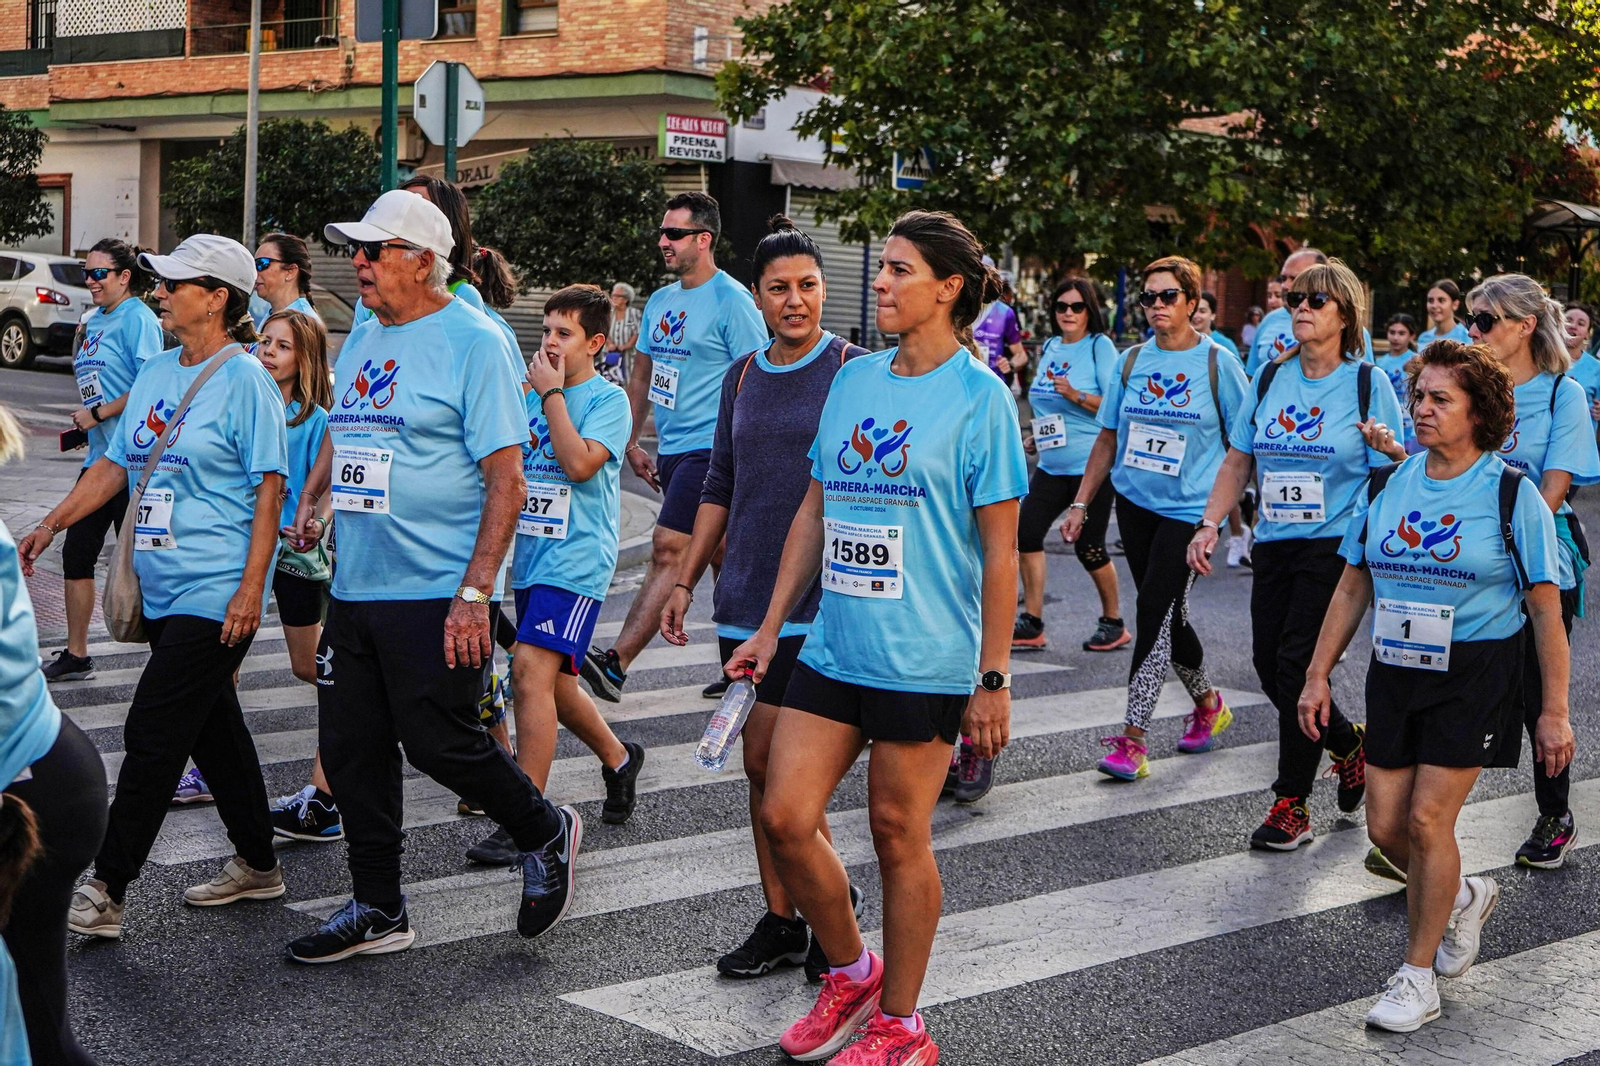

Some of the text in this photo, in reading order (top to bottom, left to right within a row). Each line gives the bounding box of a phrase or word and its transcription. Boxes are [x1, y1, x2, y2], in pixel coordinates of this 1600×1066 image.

[673, 135, 717, 148] PRENSA
[669, 146, 723, 160] REVISTAS
[654, 374, 671, 391] 904
[81, 384, 96, 400] 902
[1124, 406, 1201, 420] CARRERA-MARCHA
[1039, 423, 1056, 437] 426
[1146, 438, 1167, 454] 17
[341, 463, 365, 485] 66
[825, 494, 919, 508] SOLIDARIA ASPACE GRANADA
[1279, 486, 1302, 502] 13
[137, 505, 152, 525] 67
[838, 523, 882, 534] CARRERA-MARCHA
[832, 537, 889, 566] 1589
[1367, 560, 1476, 581] CARRERA-MARCHA
[1373, 571, 1467, 588] SOLIDARIA ASPACE GRANADA
[1401, 619, 1411, 639] 1
